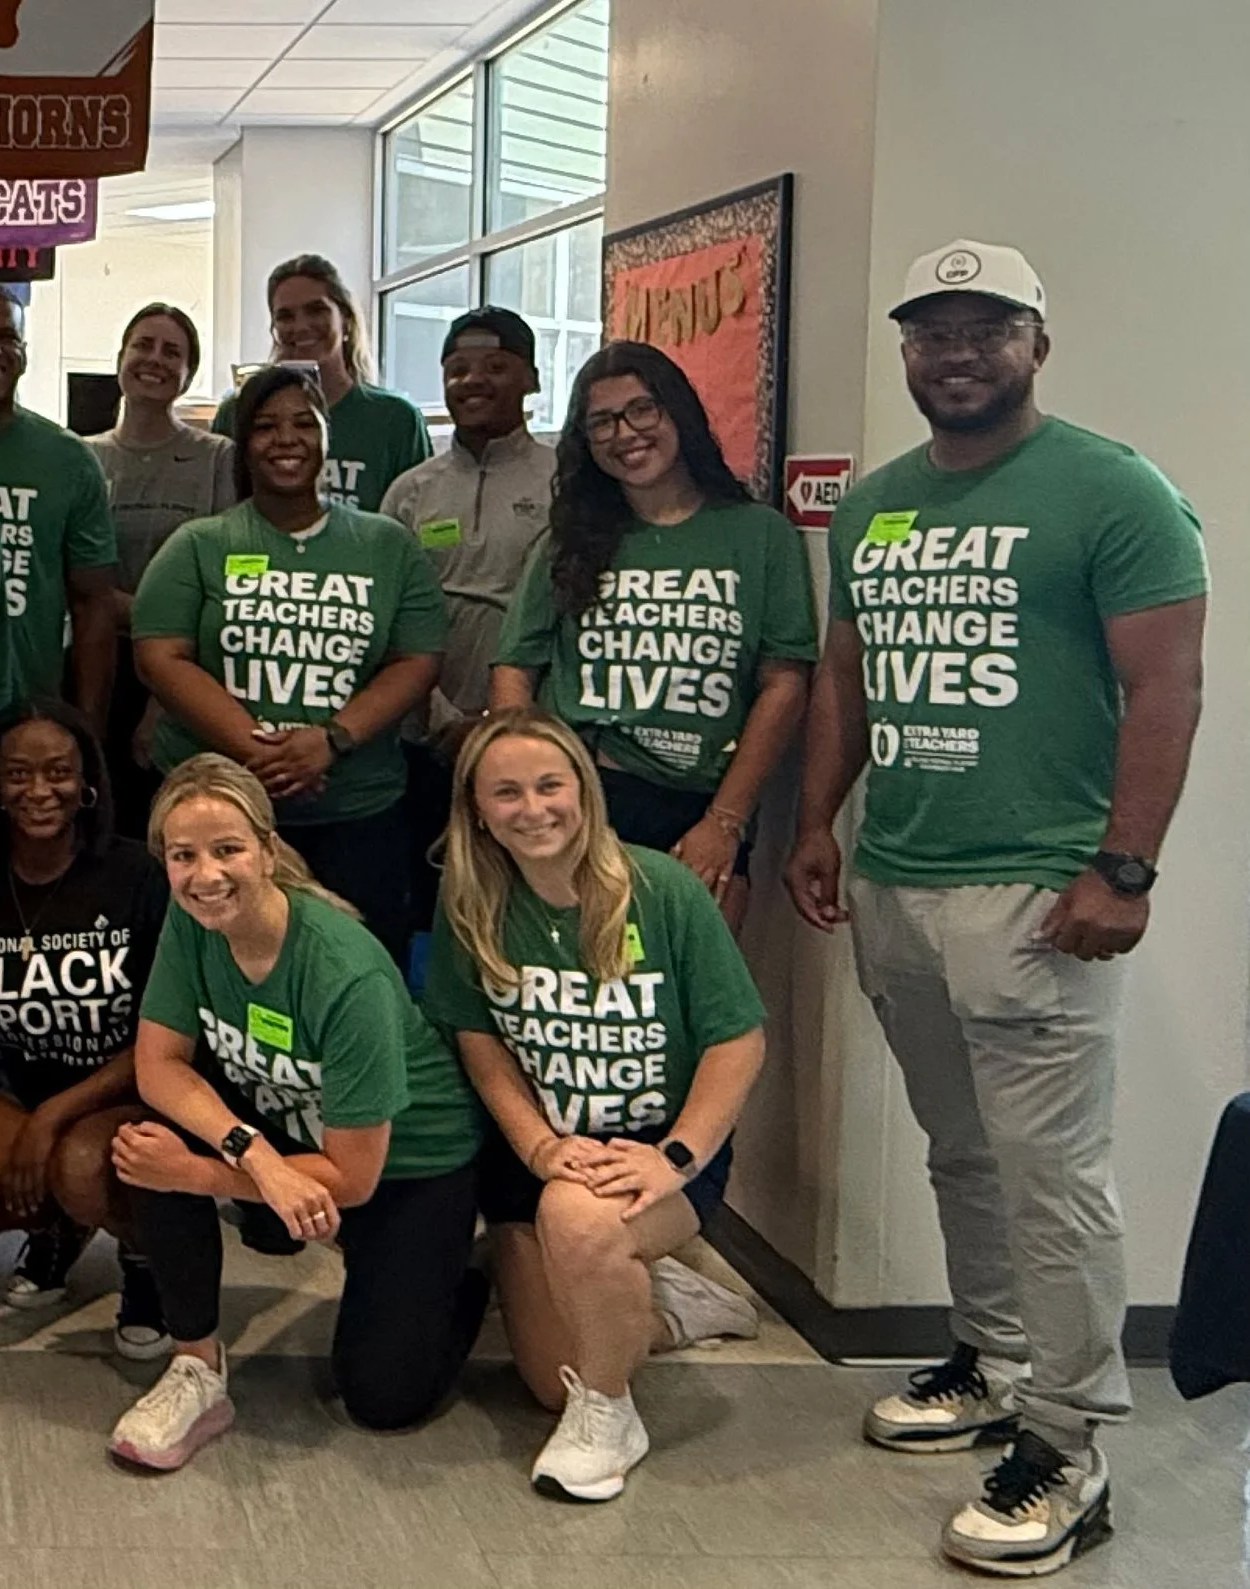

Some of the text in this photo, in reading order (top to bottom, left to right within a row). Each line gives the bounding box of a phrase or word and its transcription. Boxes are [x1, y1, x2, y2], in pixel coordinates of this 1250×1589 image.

[623, 253, 745, 345] MENUS
[814, 482, 841, 506] AED
[852, 526, 1030, 574] GREAT
[225, 570, 373, 607] GREAT
[850, 575, 1019, 608] TEACHERS
[223, 599, 374, 635] TEACHERS
[856, 610, 1019, 647] CHANGE
[220, 625, 370, 667] CHANGE
[578, 630, 742, 669] CHANGE
[223, 656, 358, 711] LIVES
[579, 663, 733, 718] LIVES
[862, 650, 1019, 707] LIVES
[41, 931, 106, 951] SOCIETY
[110, 928, 131, 946] OF
[490, 1007, 667, 1053] TEACHERS
[533, 1079, 667, 1136] VES
